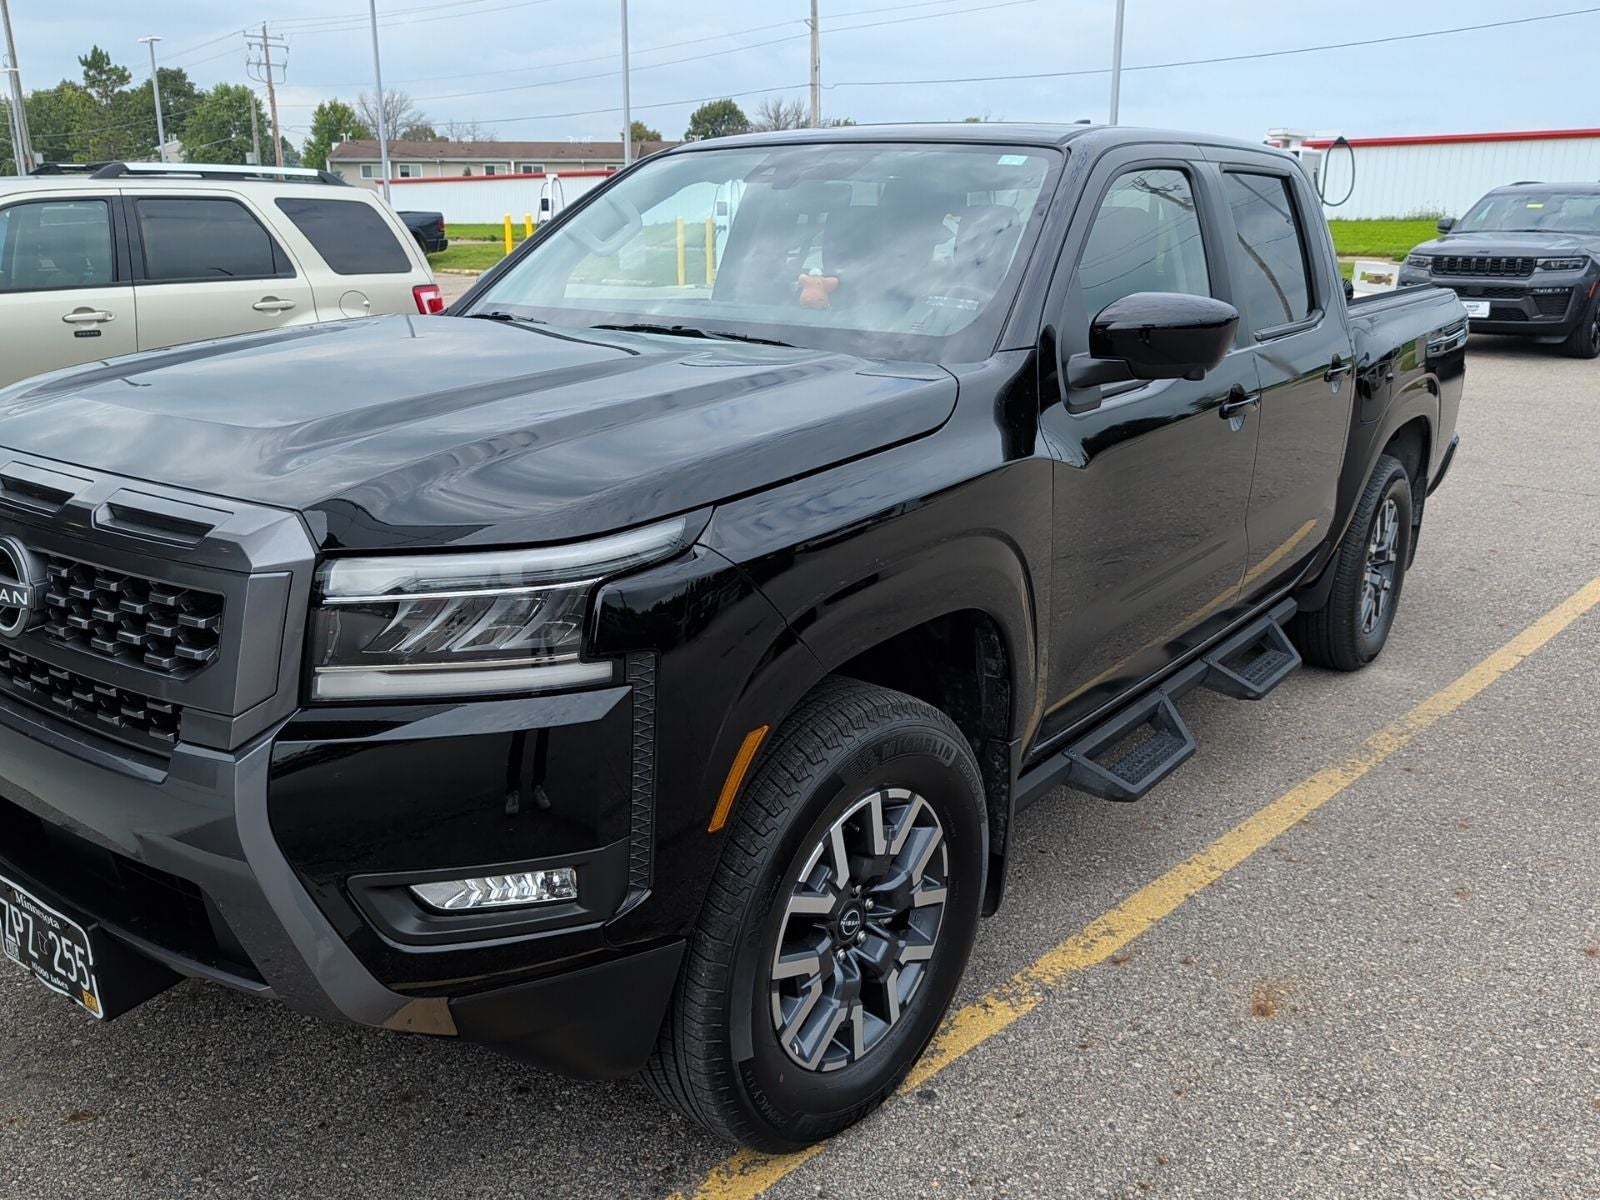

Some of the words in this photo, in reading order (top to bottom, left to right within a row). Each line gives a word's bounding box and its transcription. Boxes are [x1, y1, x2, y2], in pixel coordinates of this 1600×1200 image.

[882, 735, 954, 763] MICHELIN
[14, 890, 61, 930] Minnesota
[0, 896, 39, 959] ZPZ
[48, 930, 91, 991] 255
